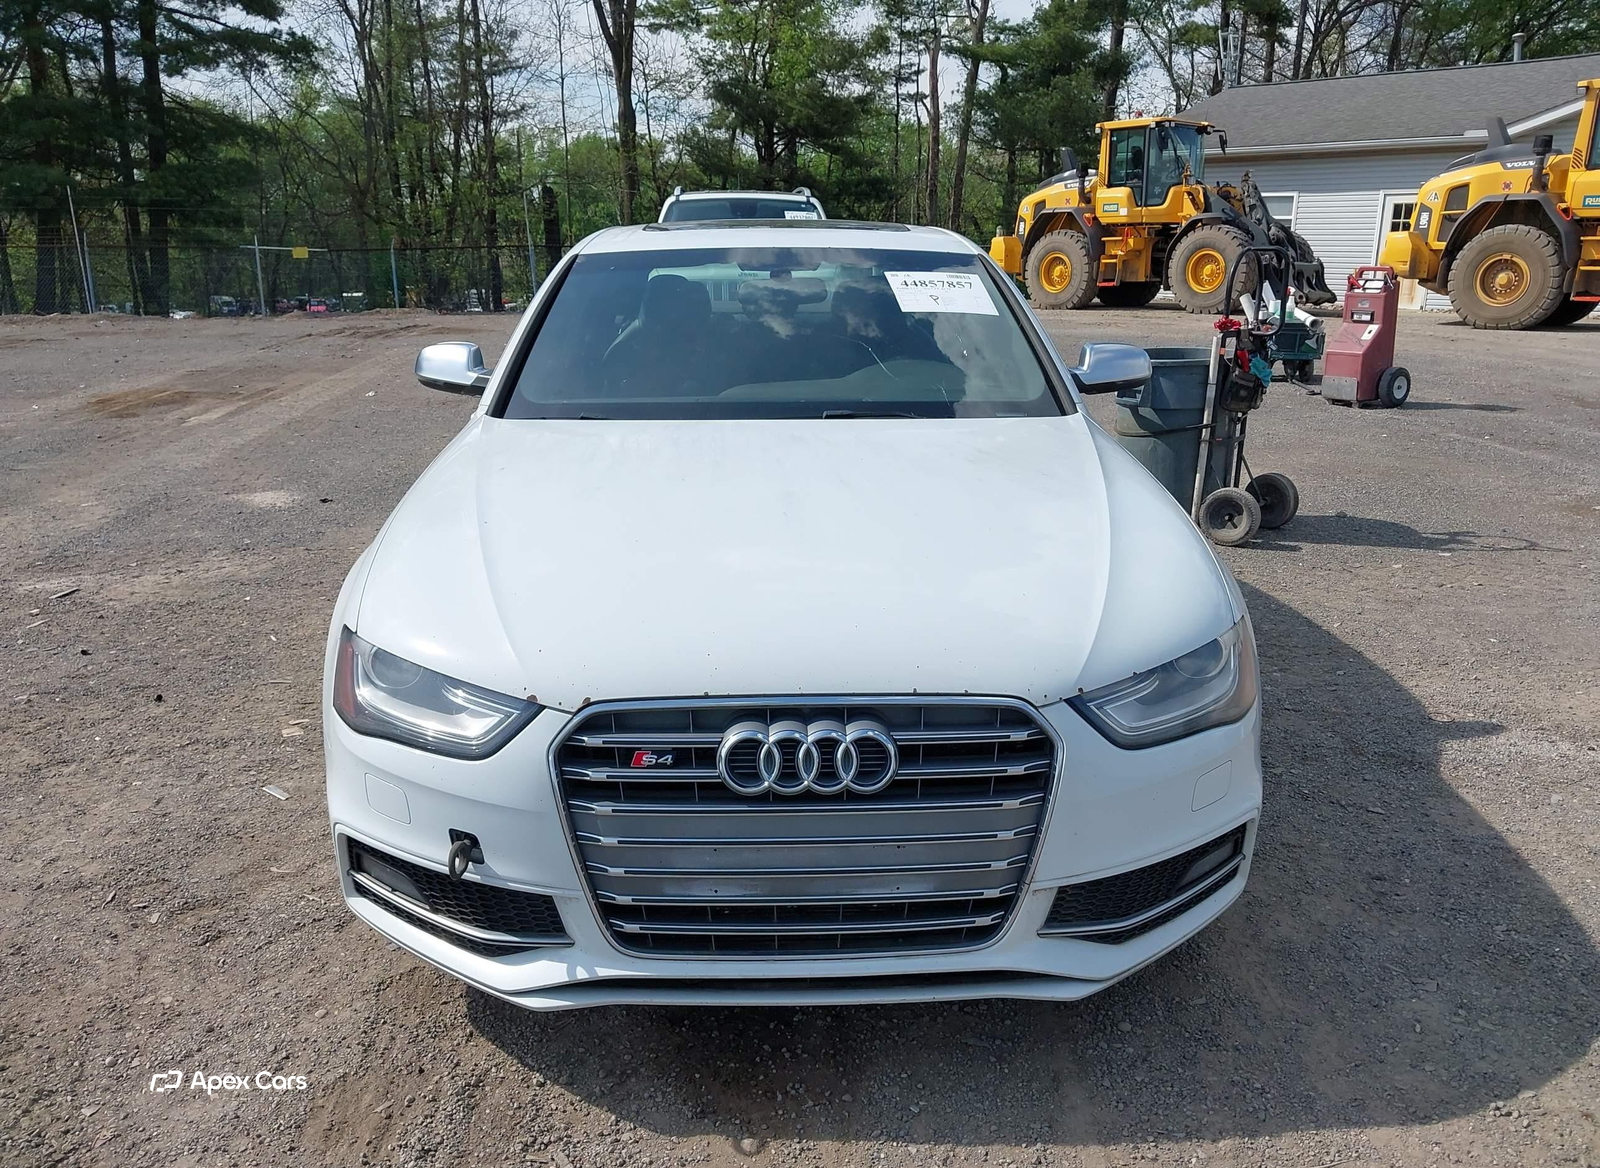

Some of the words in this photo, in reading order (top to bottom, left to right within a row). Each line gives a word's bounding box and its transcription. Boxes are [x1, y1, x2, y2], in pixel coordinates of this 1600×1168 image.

[1505, 160, 1536, 168] VOLV
[1067, 180, 1090, 188] VOLO
[1418, 212, 1430, 229] L90H
[900, 279, 973, 290] 44857857
[640, 754, 673, 765] S4
